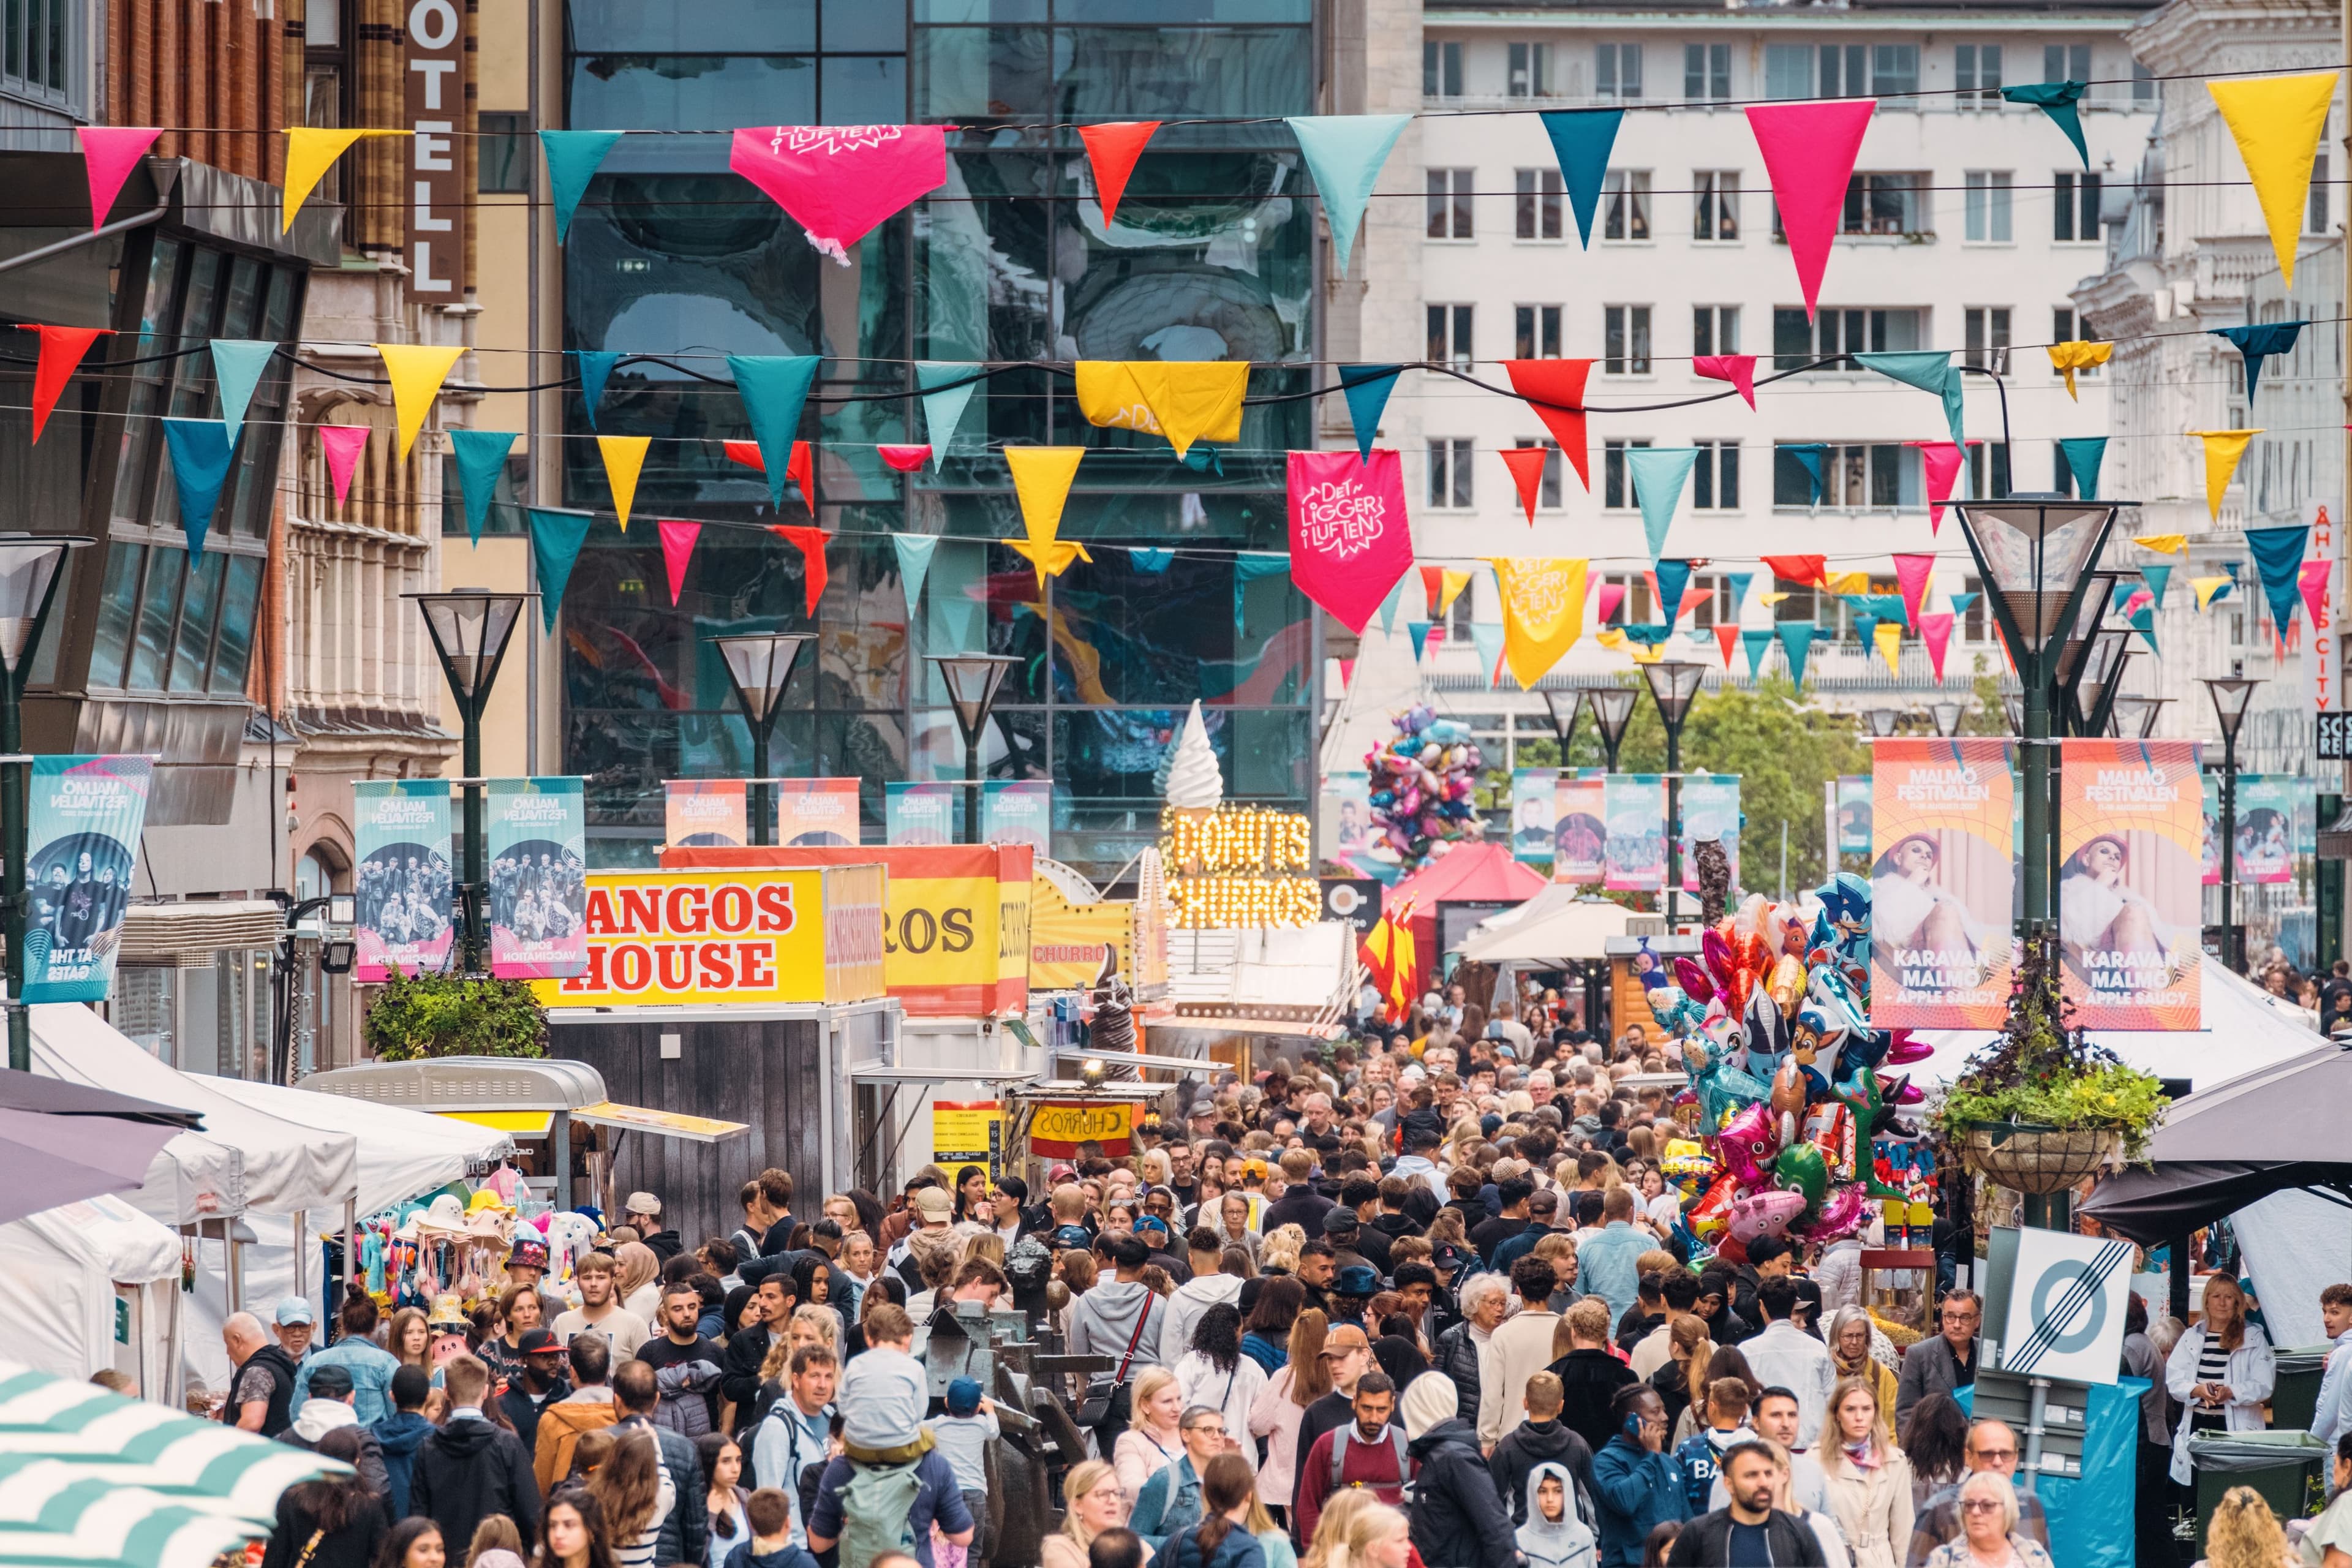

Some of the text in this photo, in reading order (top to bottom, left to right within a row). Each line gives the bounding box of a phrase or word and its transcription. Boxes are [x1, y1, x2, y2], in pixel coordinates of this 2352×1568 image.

[2315, 638, 2331, 711] CITY
[1910, 767, 1977, 785] MALMÖ
[2097, 768, 2166, 786] MALMÖ
[1898, 785, 1989, 801] FESTIVALEN
[2086, 785, 2178, 802] FESTIVALEN
[1175, 813, 1311, 870] DONUTS
[586, 886, 793, 935] ANGOS
[1164, 876, 1321, 929] CHURROS
[1032, 944, 1107, 963] CHURRO
[1894, 950, 1990, 967] KARAVAN
[2082, 951, 2179, 968] KARAVAN
[1903, 968, 1980, 987] MALMÖ
[2092, 968, 2169, 988] MALMÖ
[1896, 990, 1942, 1003] APPLE
[1946, 990, 1998, 1004] SAUCY
[2086, 992, 2131, 1005] APPLE
[2135, 992, 2188, 1005] SAUCY
